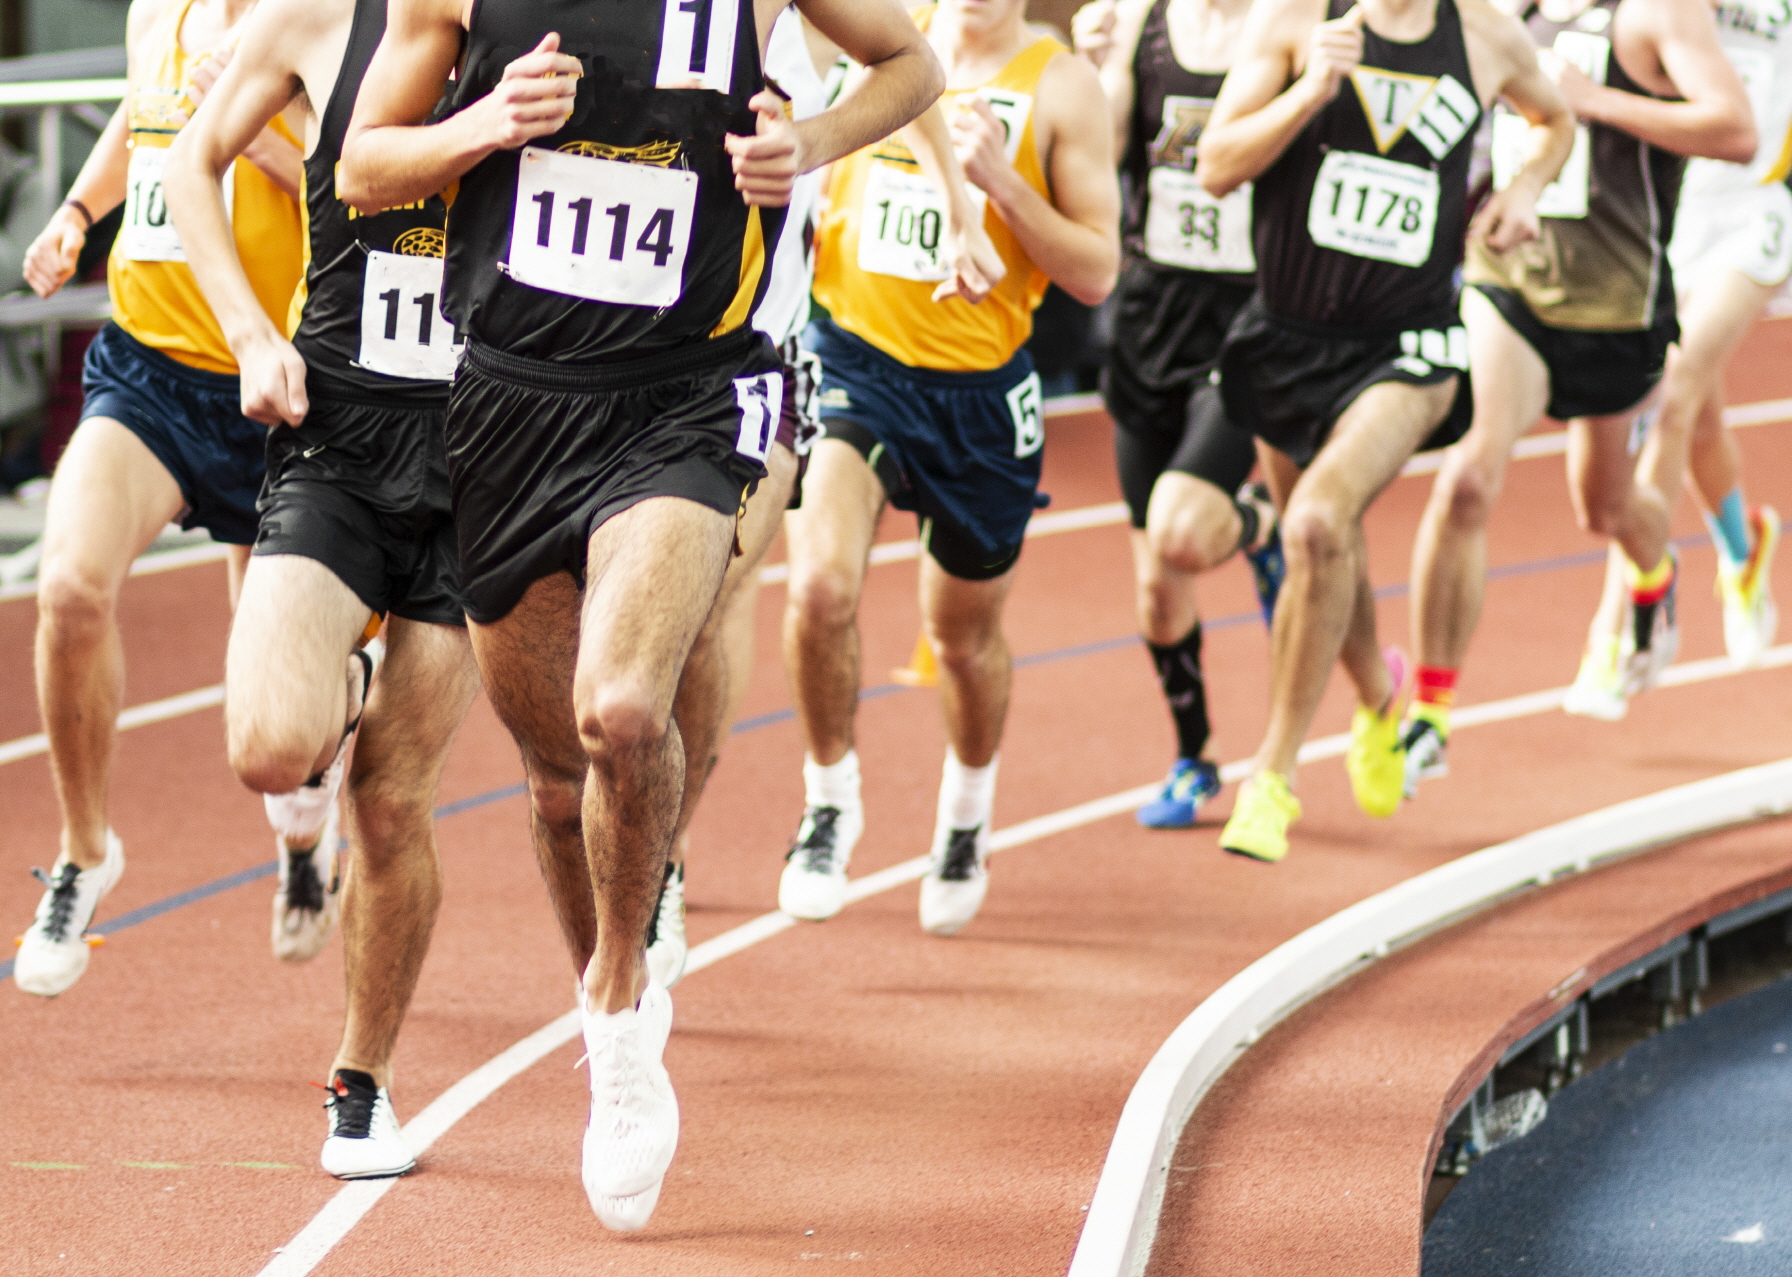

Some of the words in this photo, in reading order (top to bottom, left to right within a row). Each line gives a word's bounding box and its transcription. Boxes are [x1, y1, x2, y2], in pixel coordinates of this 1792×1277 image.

[1373, 78, 1411, 124] T
[1415, 93, 1465, 144] 11
[134, 181, 176, 227] 10
[532, 191, 674, 267] 1114
[1329, 180, 1422, 234] 1178
[1761, 212, 1784, 259] 3
[379, 288, 465, 346] 11
[747, 377, 772, 454] 1
[1018, 386, 1036, 447] 5
